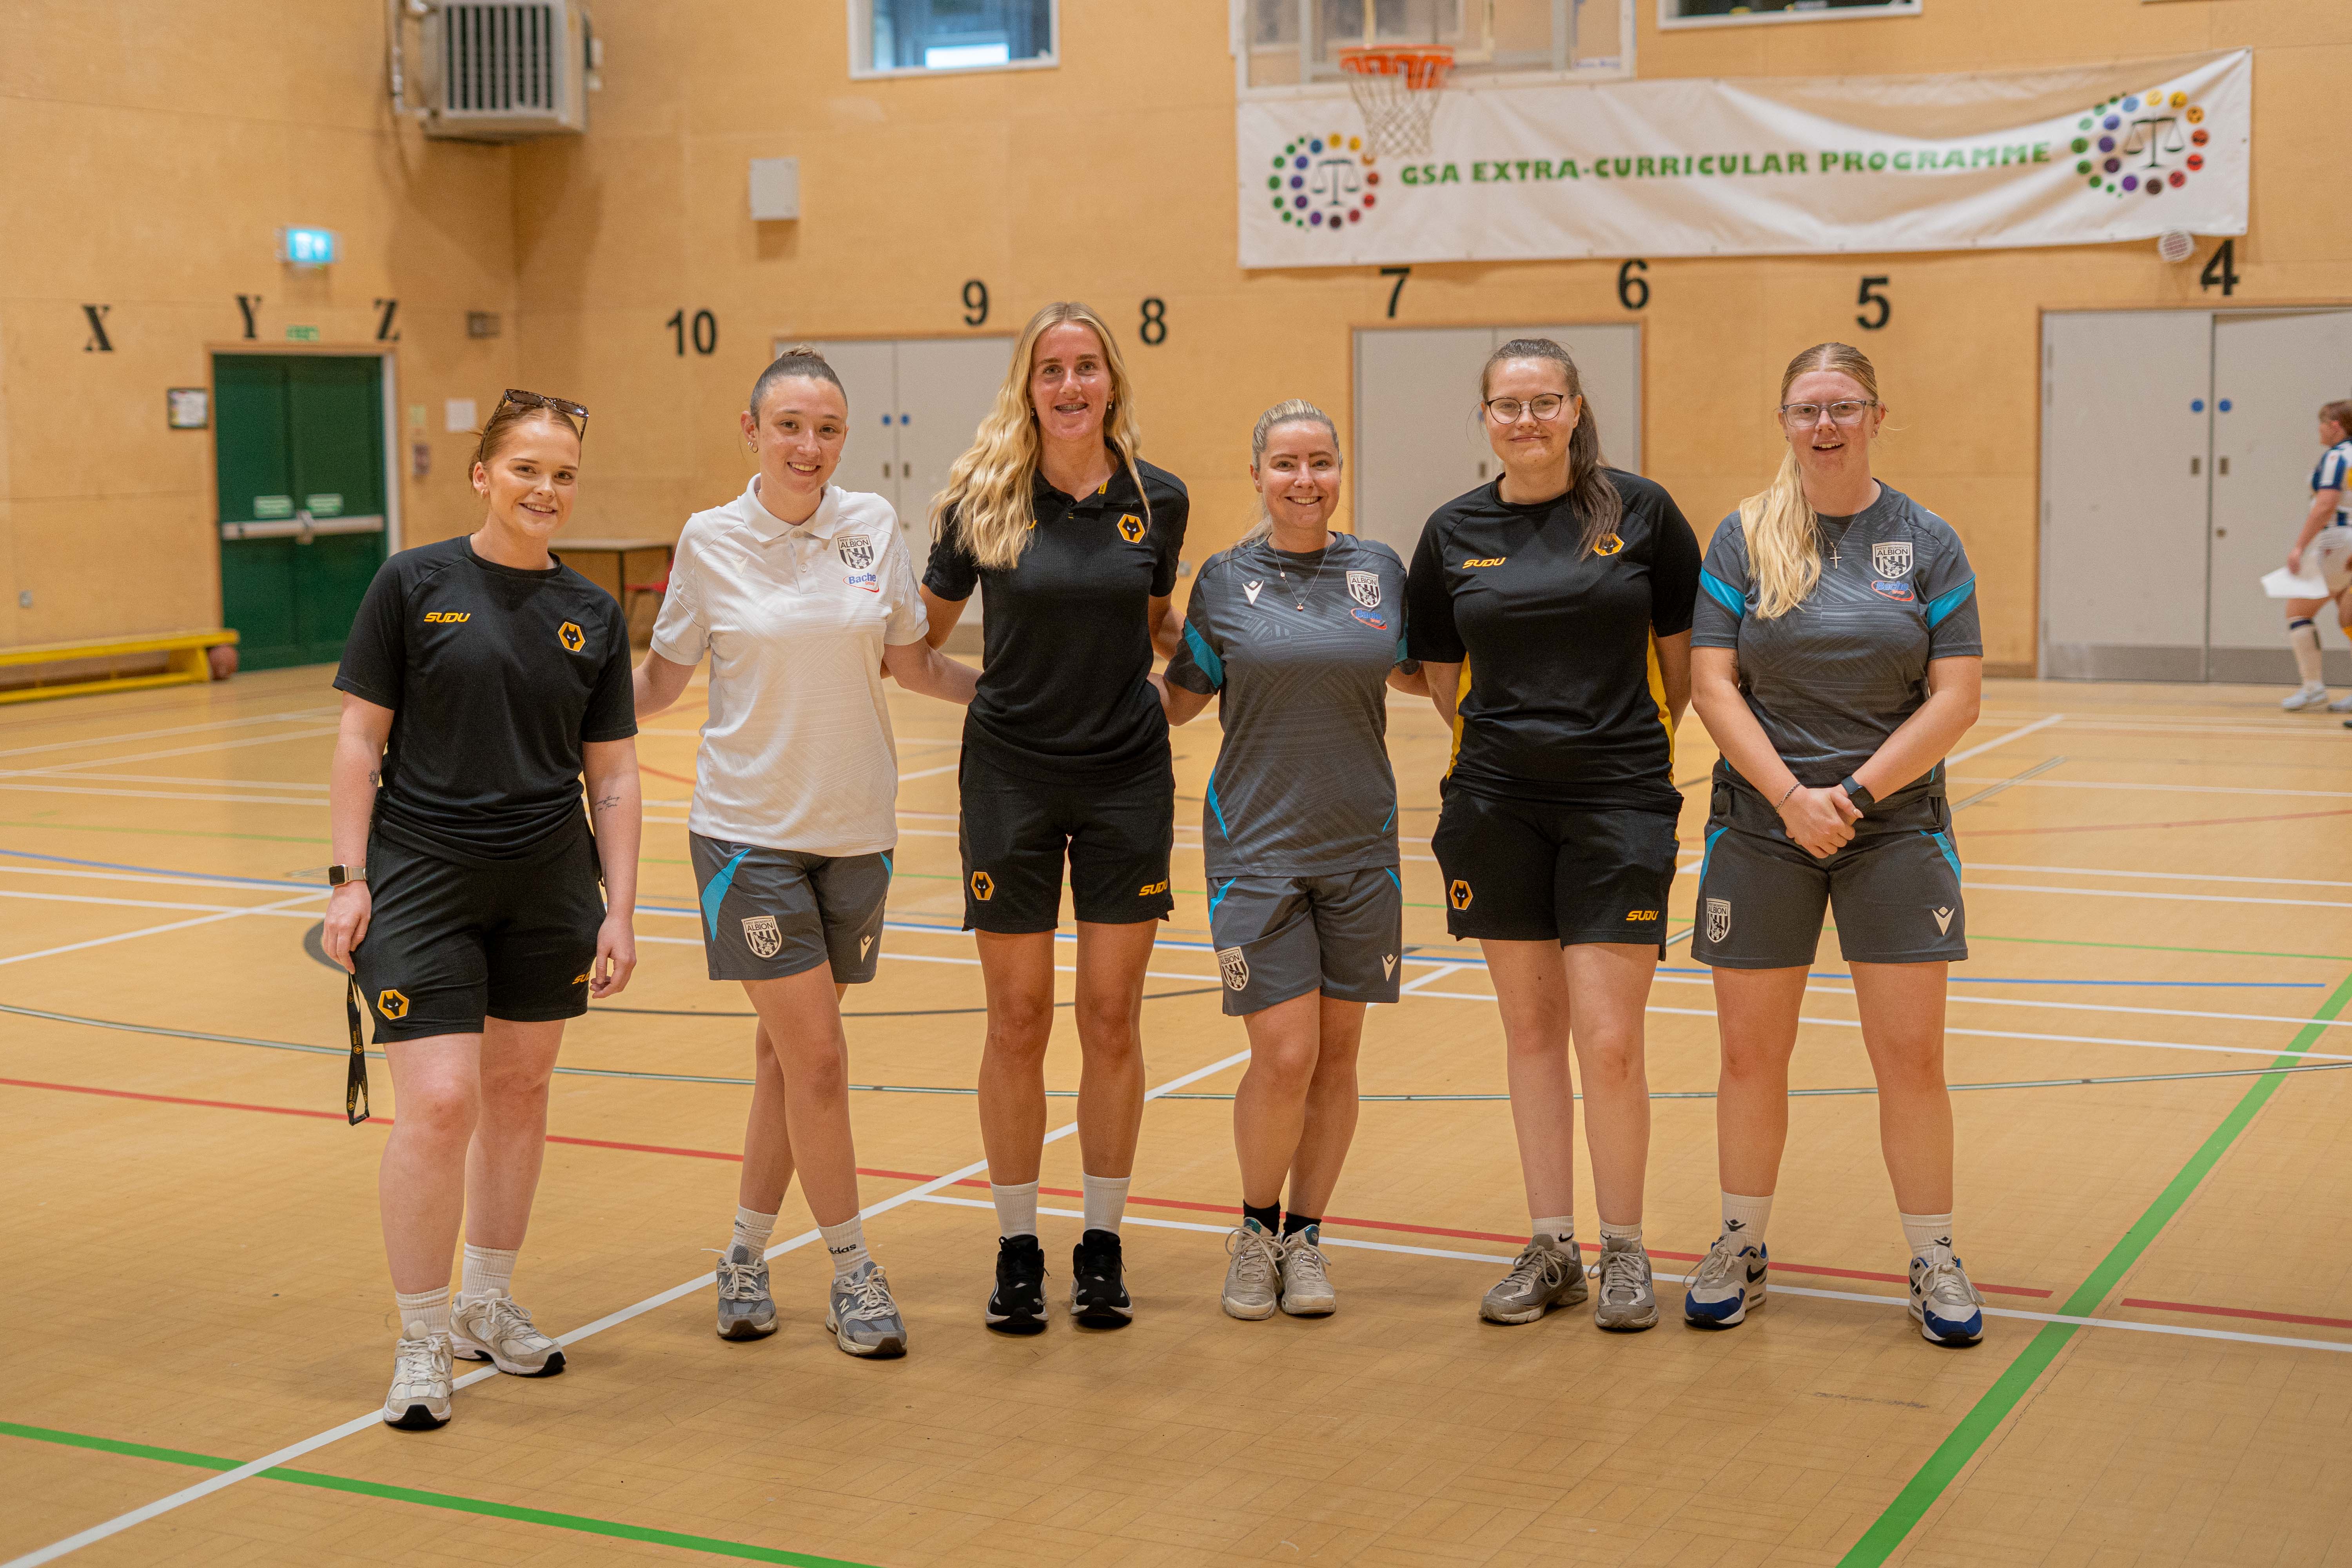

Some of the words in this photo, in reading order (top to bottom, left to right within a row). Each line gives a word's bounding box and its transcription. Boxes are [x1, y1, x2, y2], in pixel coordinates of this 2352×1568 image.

[1401, 164, 1460, 185] GSA
[1472, 152, 1808, 181] EXTRA-CURRICULAR
[1821, 142, 2051, 172] PROGRAMME
[1617, 258, 1650, 311] 6
[2199, 237, 2239, 297] 4
[962, 280, 989, 327] 9
[1378, 265, 1413, 319] 7
[1856, 276, 1891, 331] 5
[83, 305, 114, 352] X
[236, 295, 261, 339] Y
[374, 299, 400, 341] Z
[666, 309, 718, 356] 10
[1139, 298, 1167, 346] 8
[840, 539, 869, 548] ALBION
[1462, 557, 1506, 569] SUDU
[849, 573, 876, 584] Bache
[1876, 581, 1909, 591] Bache
[424, 612, 471, 623] SUDU
[1139, 878, 1168, 896] SUDU
[748, 922, 773, 931] ALBION
[1626, 911, 1659, 920] SUDU
[1709, 906, 1726, 915] ALBION
[1220, 954, 1240, 965] ALBION
